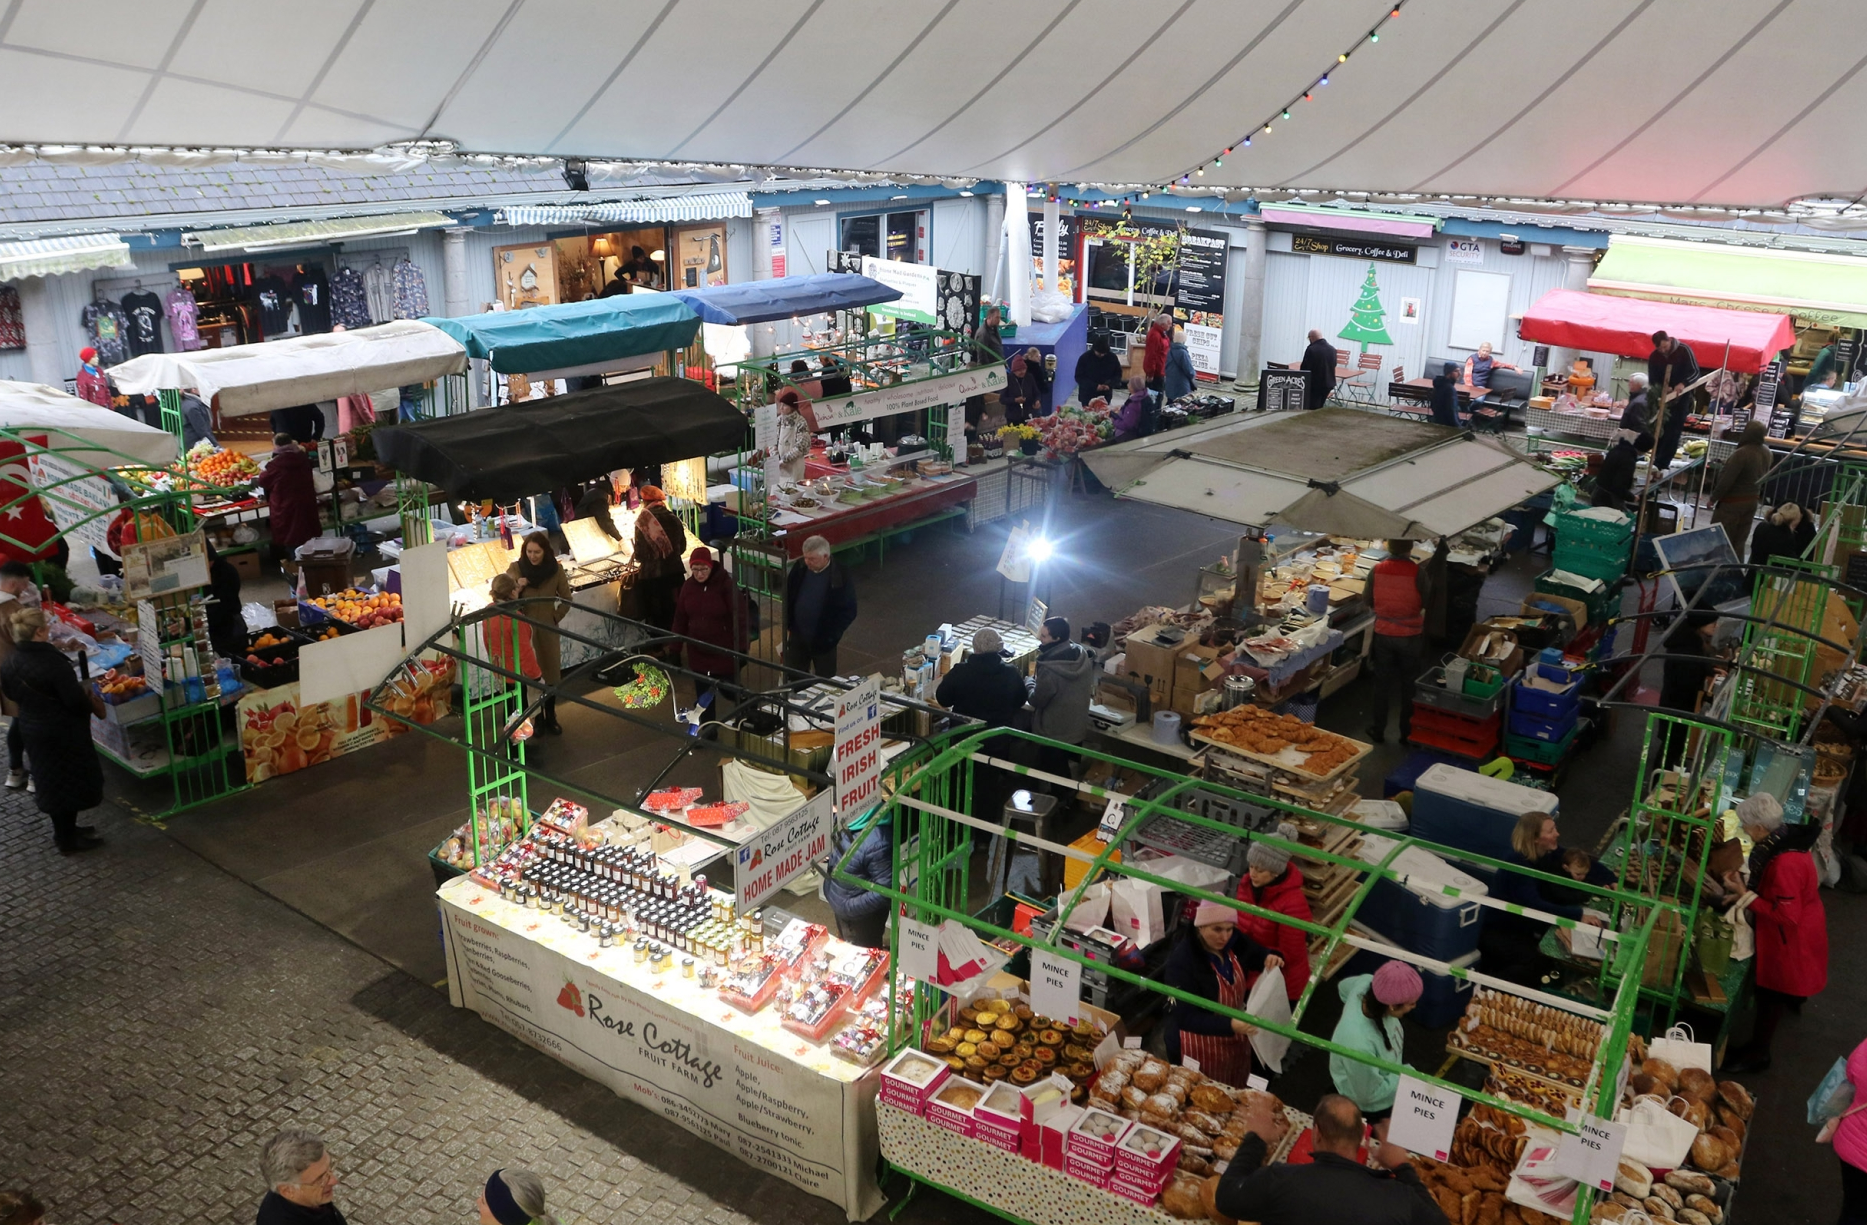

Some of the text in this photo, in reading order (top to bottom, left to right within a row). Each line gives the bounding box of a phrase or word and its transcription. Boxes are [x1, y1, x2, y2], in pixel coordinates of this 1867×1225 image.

[1142, 227, 1159, 236] Coffee
[1311, 242, 1329, 252] Shop
[1336, 244, 1408, 258] Grocery, Coffee & Deli
[1449, 250, 1480, 258] SECURITY
[1460, 242, 1480, 252] GTA
[1790, 308, 1839, 322] Coffee
[986, 374, 1006, 387] Kale
[914, 398, 927, 406] Based
[928, 394, 939, 403] Food
[843, 404, 862, 417] Kale
[846, 701, 858, 712] Rose
[859, 690, 877, 705] Cottage
[838, 724, 849, 734] Find
[857, 716, 863, 724] on
[838, 722, 879, 763] FRESH
[842, 750, 876, 785] IRISH
[842, 774, 878, 812] FRUIT
[761, 808, 809, 844] Tel: 087 9563125
[764, 839, 784, 859] Rose
[787, 816, 820, 844] Cottage
[744, 833, 826, 904] HOME MADE JAM
[454, 914, 500, 940] Fruit grown:
[908, 928, 930, 941] MINCE
[911, 941, 925, 951] PIES
[494, 948, 530, 970] Raspberries,
[1042, 962, 1069, 978] MINCE
[492, 968, 532, 993] Gooseberries,
[1046, 976, 1063, 989] PIES
[506, 995, 532, 1014] Rhubarb.
[588, 993, 722, 1088] Rose Cottage
[638, 1047, 699, 1084] FRUIT FARM
[734, 1044, 784, 1075] Fruit Juice:
[735, 1065, 761, 1086] Apple,
[884, 1078, 919, 1096] GOURMET
[736, 1079, 809, 1119] Apple/Raspberry,
[884, 1096, 918, 1114] GOURMET
[886, 1088, 920, 1105] GOURMET
[1410, 1090, 1445, 1110] MINCE
[633, 1083, 660, 1100] Mob's:
[710, 1120, 730, 1138] Mary
[736, 1093, 815, 1135] Apple/Strawberry,
[931, 1105, 967, 1123] GOURMET
[1414, 1106, 1436, 1120] PIES
[664, 1107, 730, 1148] 087-9563125 Paul
[738, 1112, 805, 1149] Blueberry tonic.
[930, 1115, 966, 1134] GOURMET
[975, 1122, 1012, 1140] GOURMET
[1582, 1124, 1611, 1140] MINCE
[975, 1132, 1012, 1150] GOURMET
[1073, 1134, 1110, 1152] GOURMET
[1581, 1137, 1601, 1150] PIES
[738, 1135, 829, 1180] 087-2541333 Michael
[1071, 1145, 1109, 1163] GOURMET
[1119, 1150, 1157, 1169] GOURMET
[740, 1147, 820, 1188] 087-2700121 Claire
[1069, 1159, 1106, 1176] GOURMET
[1069, 1167, 1106, 1185] GOURMET
[1117, 1160, 1156, 1179] GOURMET
[1119, 1172, 1158, 1190] GOURMET
[1112, 1184, 1150, 1203] GOURMET
